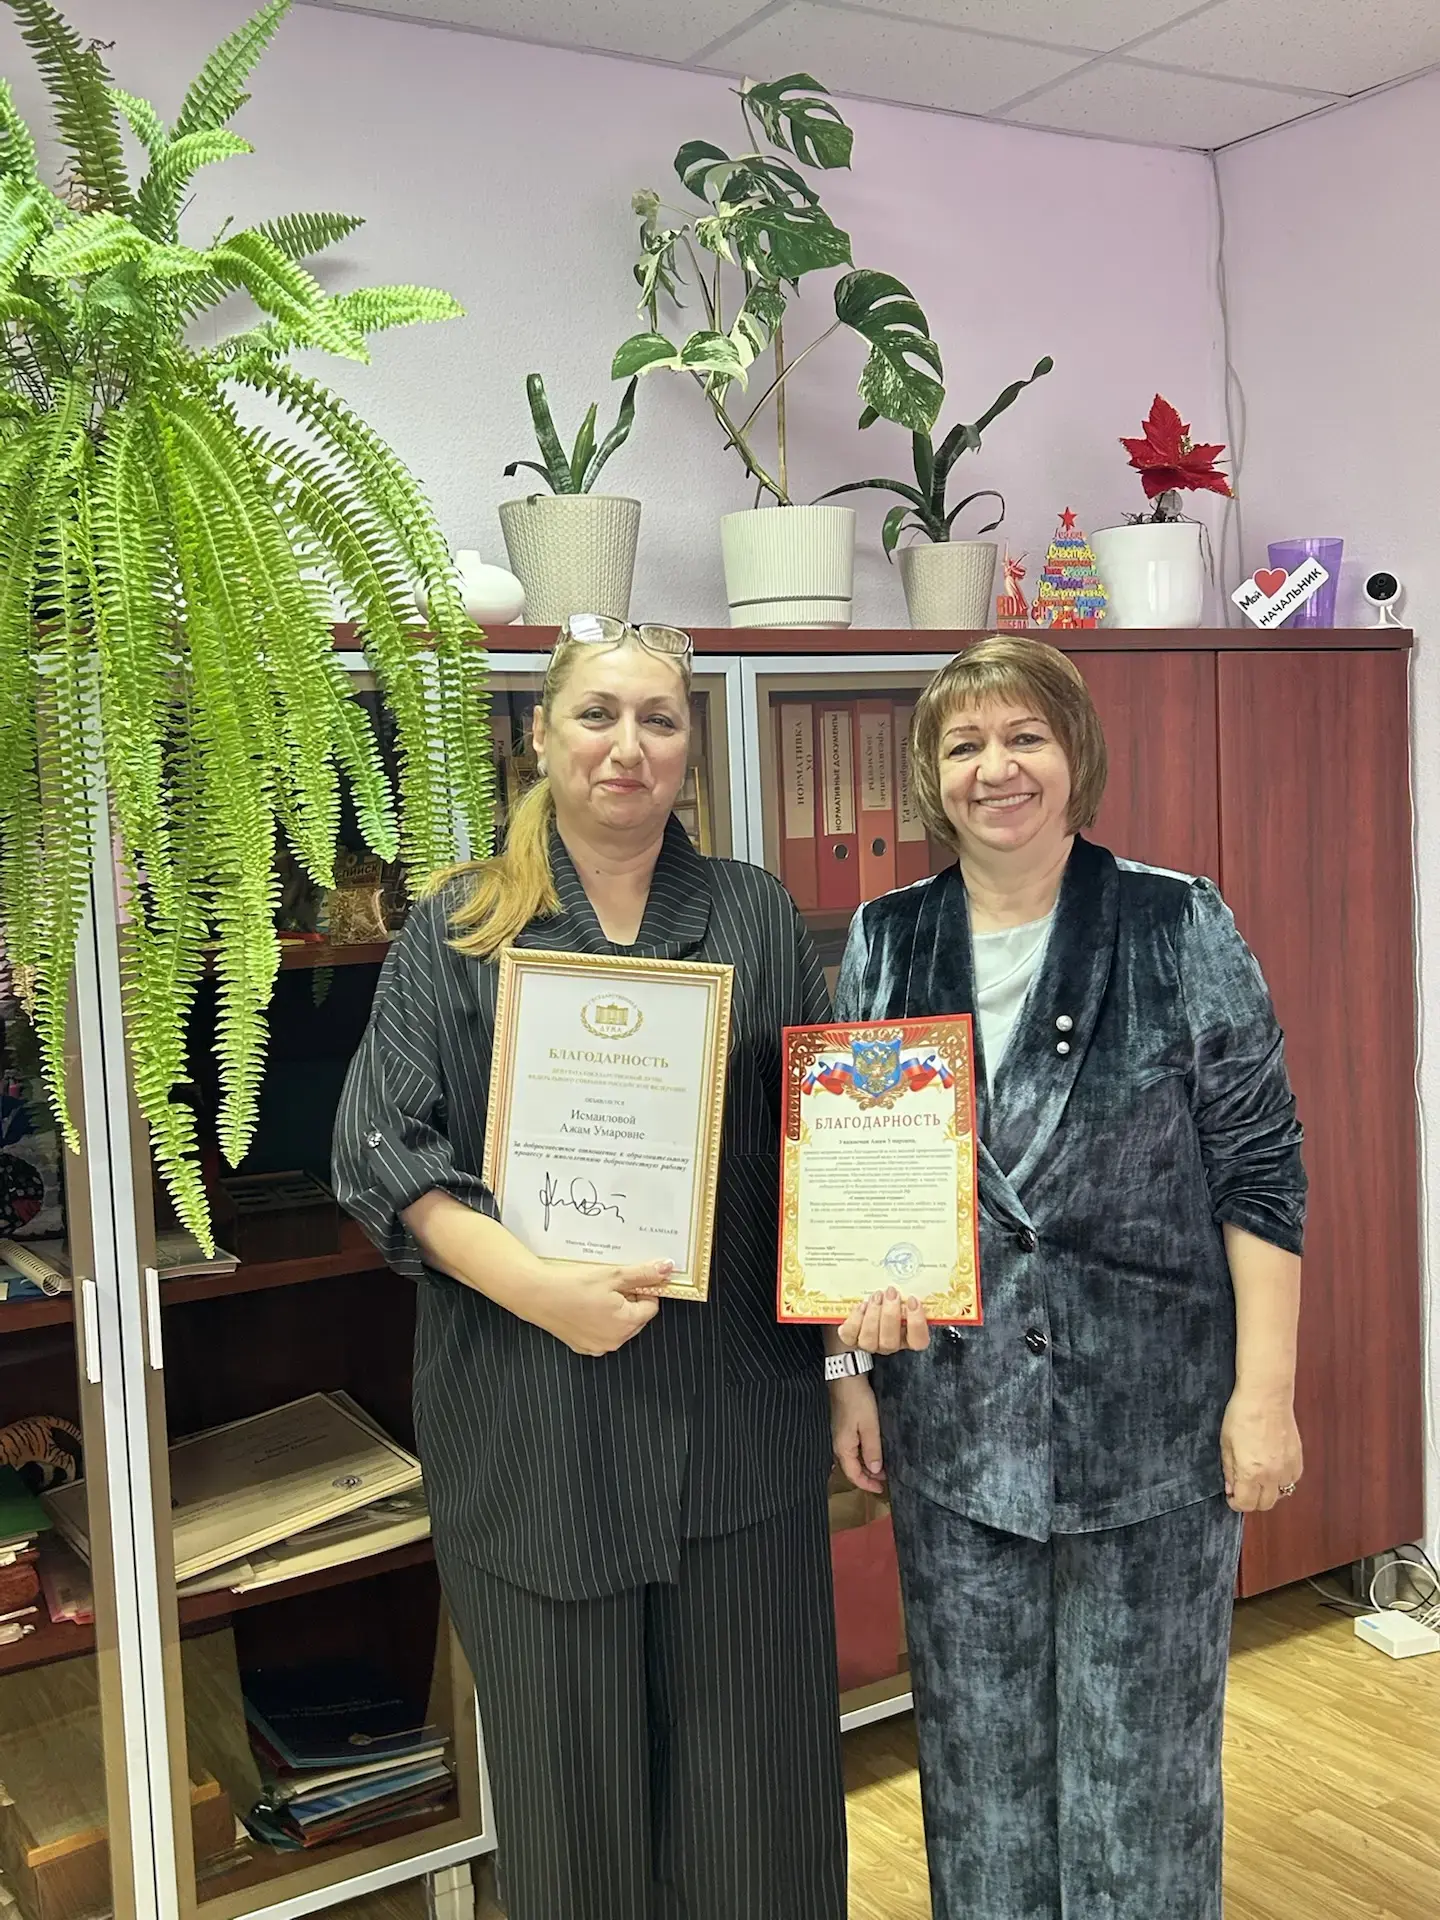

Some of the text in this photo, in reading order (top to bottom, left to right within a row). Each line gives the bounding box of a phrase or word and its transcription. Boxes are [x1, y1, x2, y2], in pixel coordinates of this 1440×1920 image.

[1238, 590, 1263, 611] Мой
[1259, 568, 1322, 627] НАЧАЛЬНИК
[795, 721, 805, 805] НОРМАТИВКА
[831, 713, 842, 831] НОРМАТИВНЫЕ ДОКУМЕНТЫ
[548, 1048, 669, 1069] БЛАГОДАРНОСТЬ
[570, 1109, 636, 1125] Исмаиловой
[815, 1113, 941, 1131] БЛАГОДАРНОСТЬ
[559, 1122, 645, 1140] Ажам Умаровне
